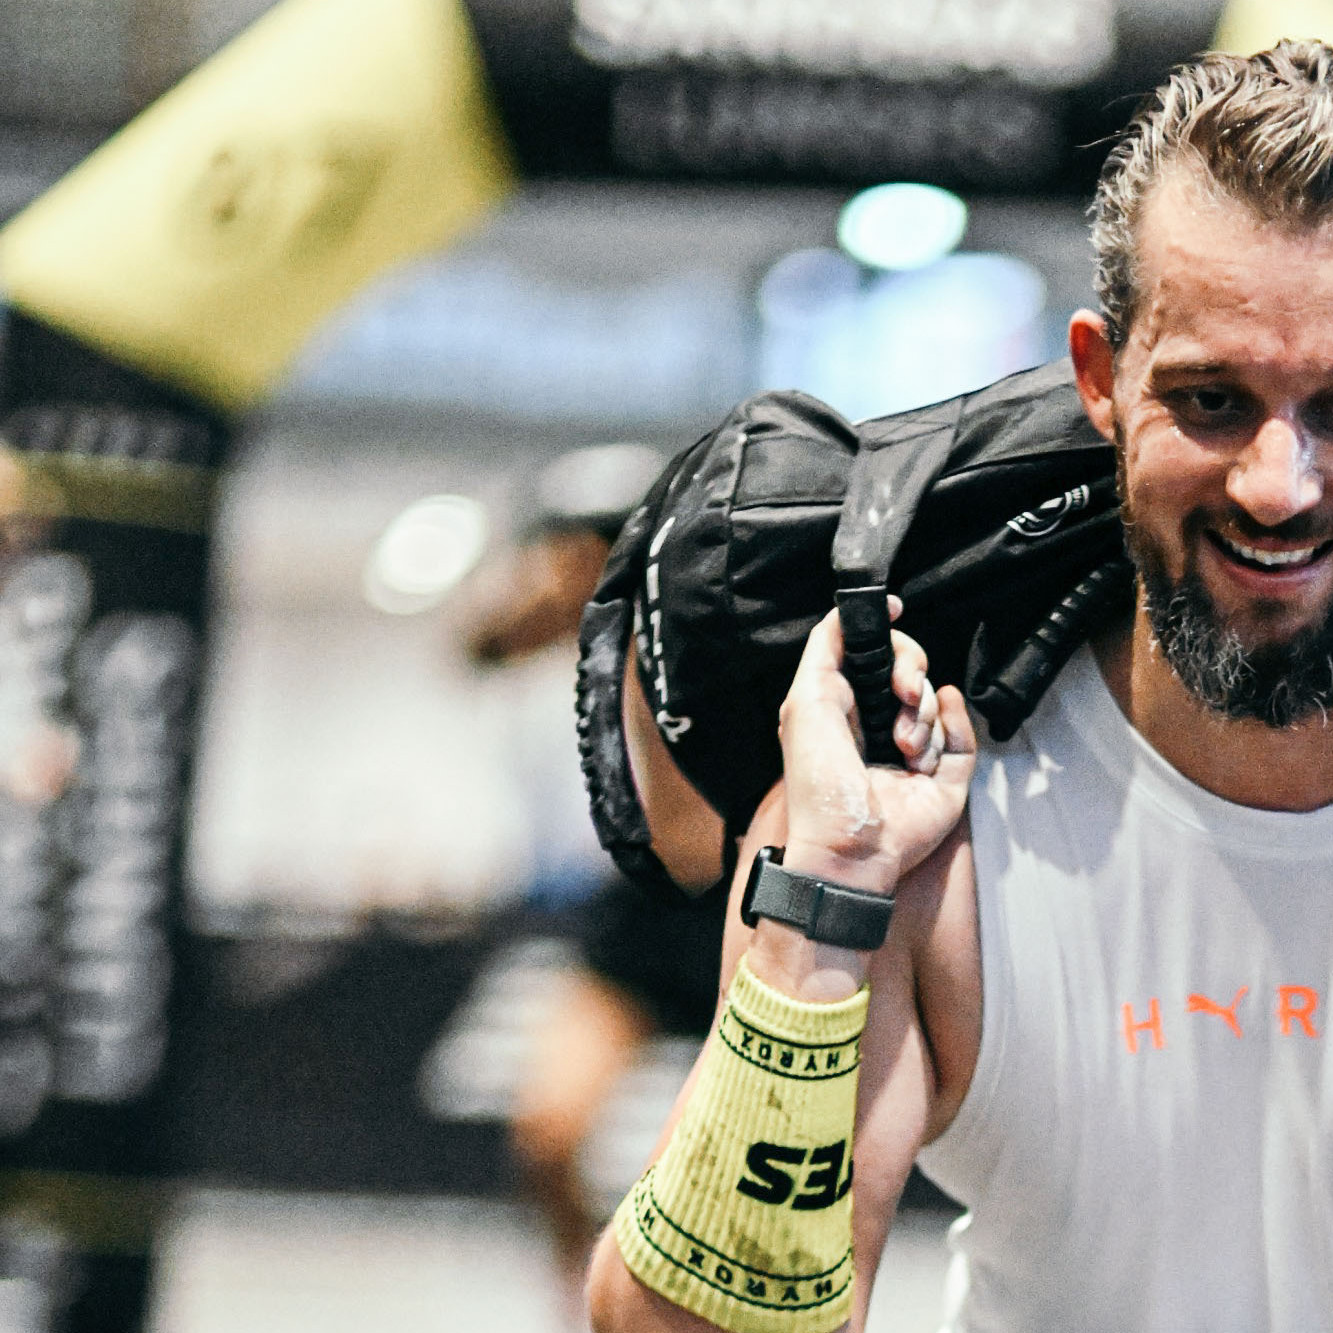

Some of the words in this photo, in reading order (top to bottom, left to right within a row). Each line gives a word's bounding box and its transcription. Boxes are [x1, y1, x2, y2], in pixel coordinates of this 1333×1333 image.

[741, 1031, 841, 1072] HYROX
[736, 1138, 854, 1211] ES
[687, 1247, 834, 1303] HYROX
